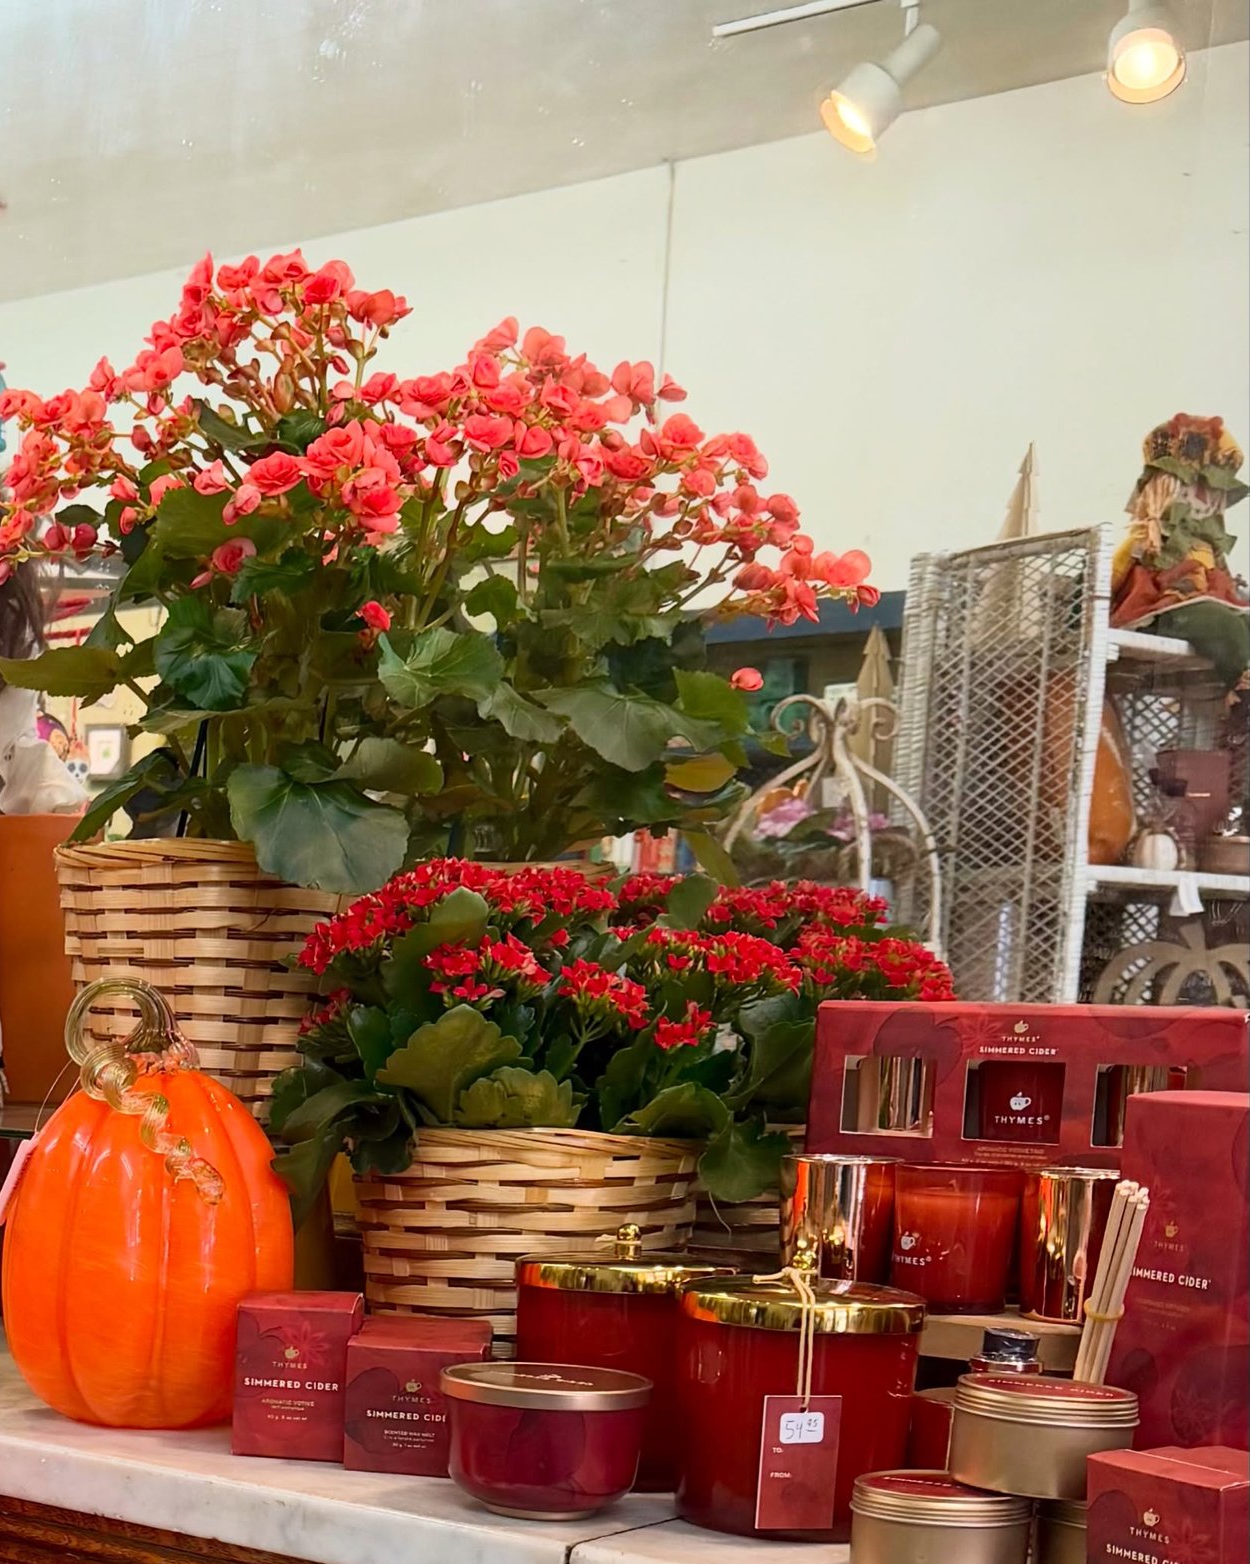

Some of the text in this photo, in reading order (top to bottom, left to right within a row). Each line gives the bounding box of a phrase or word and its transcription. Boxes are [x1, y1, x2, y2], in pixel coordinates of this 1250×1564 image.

[979, 1046, 1057, 1056] SIMMERED CIDER
[994, 1115, 1044, 1126] THYMES
[1130, 1267, 1209, 1290] IMMERED CIDER
[271, 1361, 308, 1369] THYMES
[244, 1377, 339, 1392] SIMMERED CIDER
[392, 1395, 432, 1404] THYMES
[366, 1409, 419, 1421] SIMMERED
[1129, 1526, 1170, 1545] THYMES
